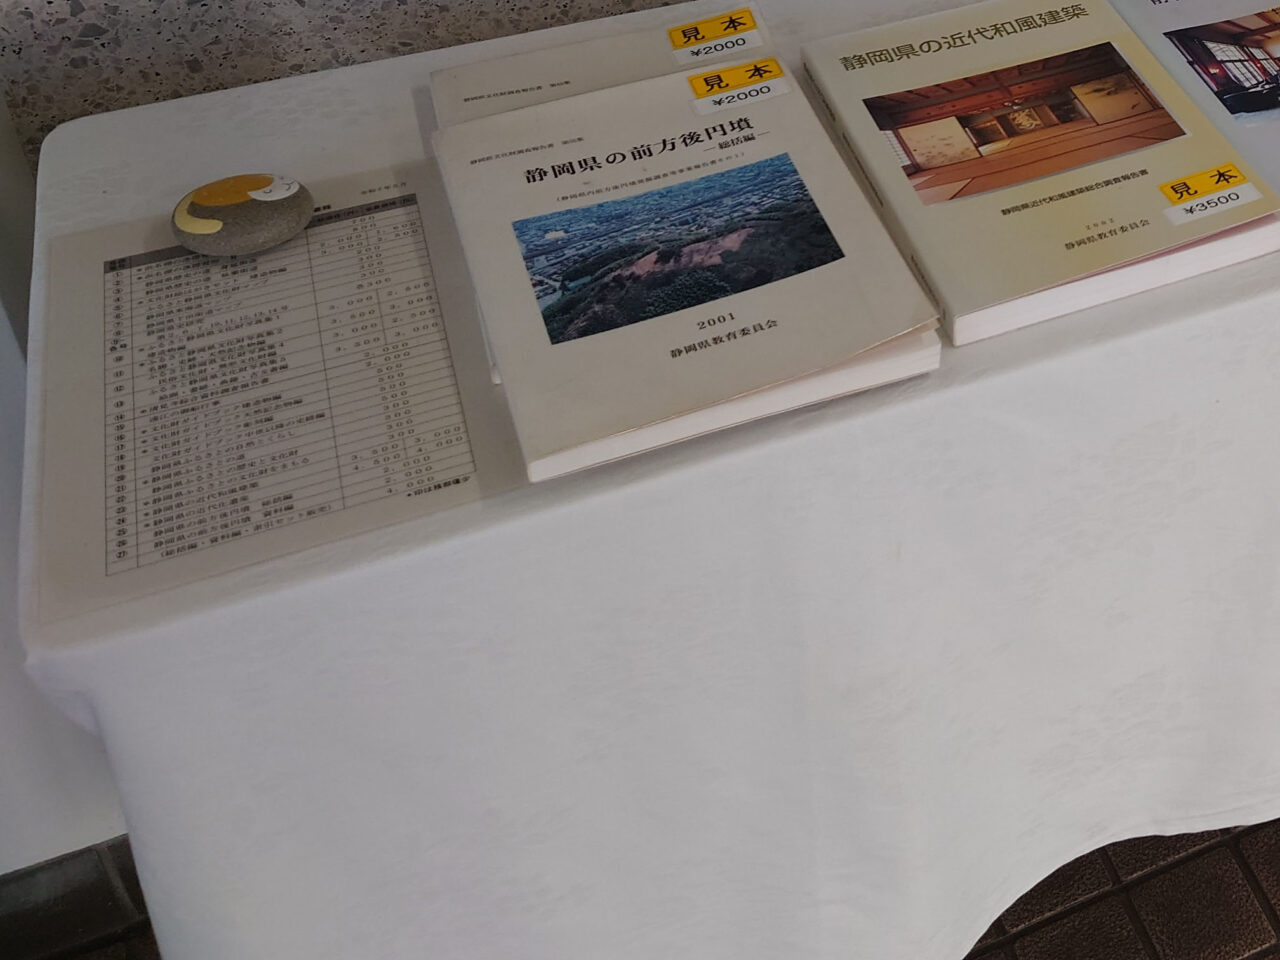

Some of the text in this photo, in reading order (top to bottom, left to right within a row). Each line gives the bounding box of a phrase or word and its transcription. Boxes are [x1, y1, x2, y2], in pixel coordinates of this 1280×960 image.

[680, 15, 748, 44] 見本
[838, 2, 1090, 72] 静岡県の近代和風建築
[689, 37, 747, 58] ¥2000
[702, 63, 774, 93] 見本
[711, 84, 772, 107] ¥2000
[524, 115, 755, 185] 静岡県の前方後円墳
[1168, 167, 1239, 201] 見本
[1182, 190, 1240, 217] ¥3500
[696, 311, 737, 330] 2001
[669, 318, 779, 359] 静岡県教育委員会
